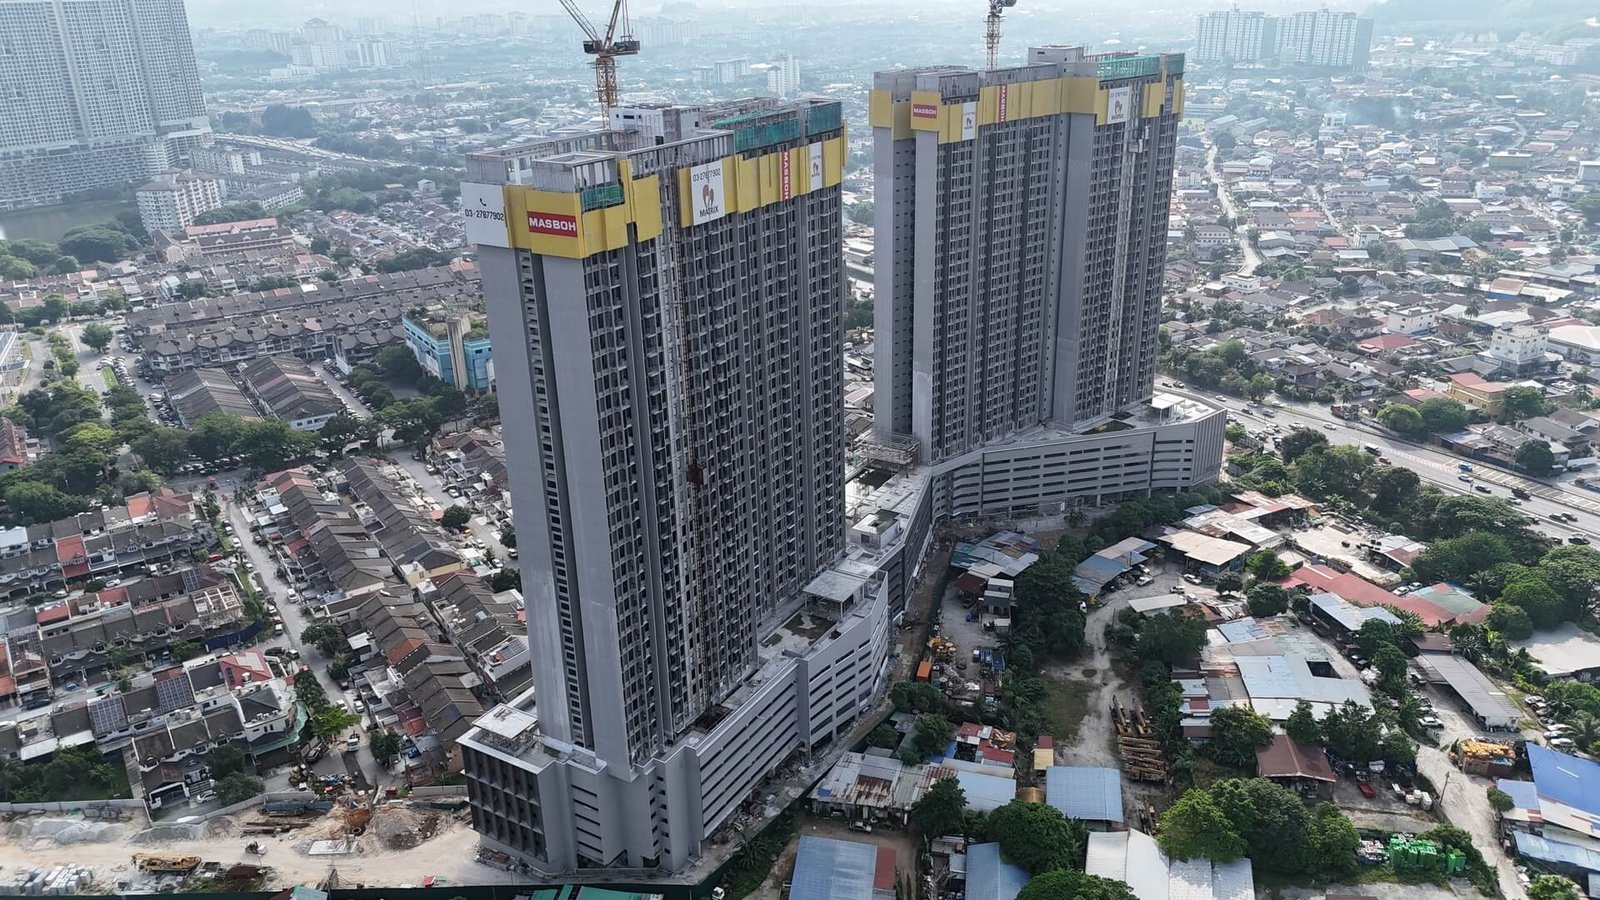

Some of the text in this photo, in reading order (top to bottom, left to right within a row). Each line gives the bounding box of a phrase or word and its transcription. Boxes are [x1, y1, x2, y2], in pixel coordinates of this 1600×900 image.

[464, 208, 505, 221] 03-27877902
[700, 204, 719, 217] MATRIX
[528, 217, 576, 231] MASBOH
